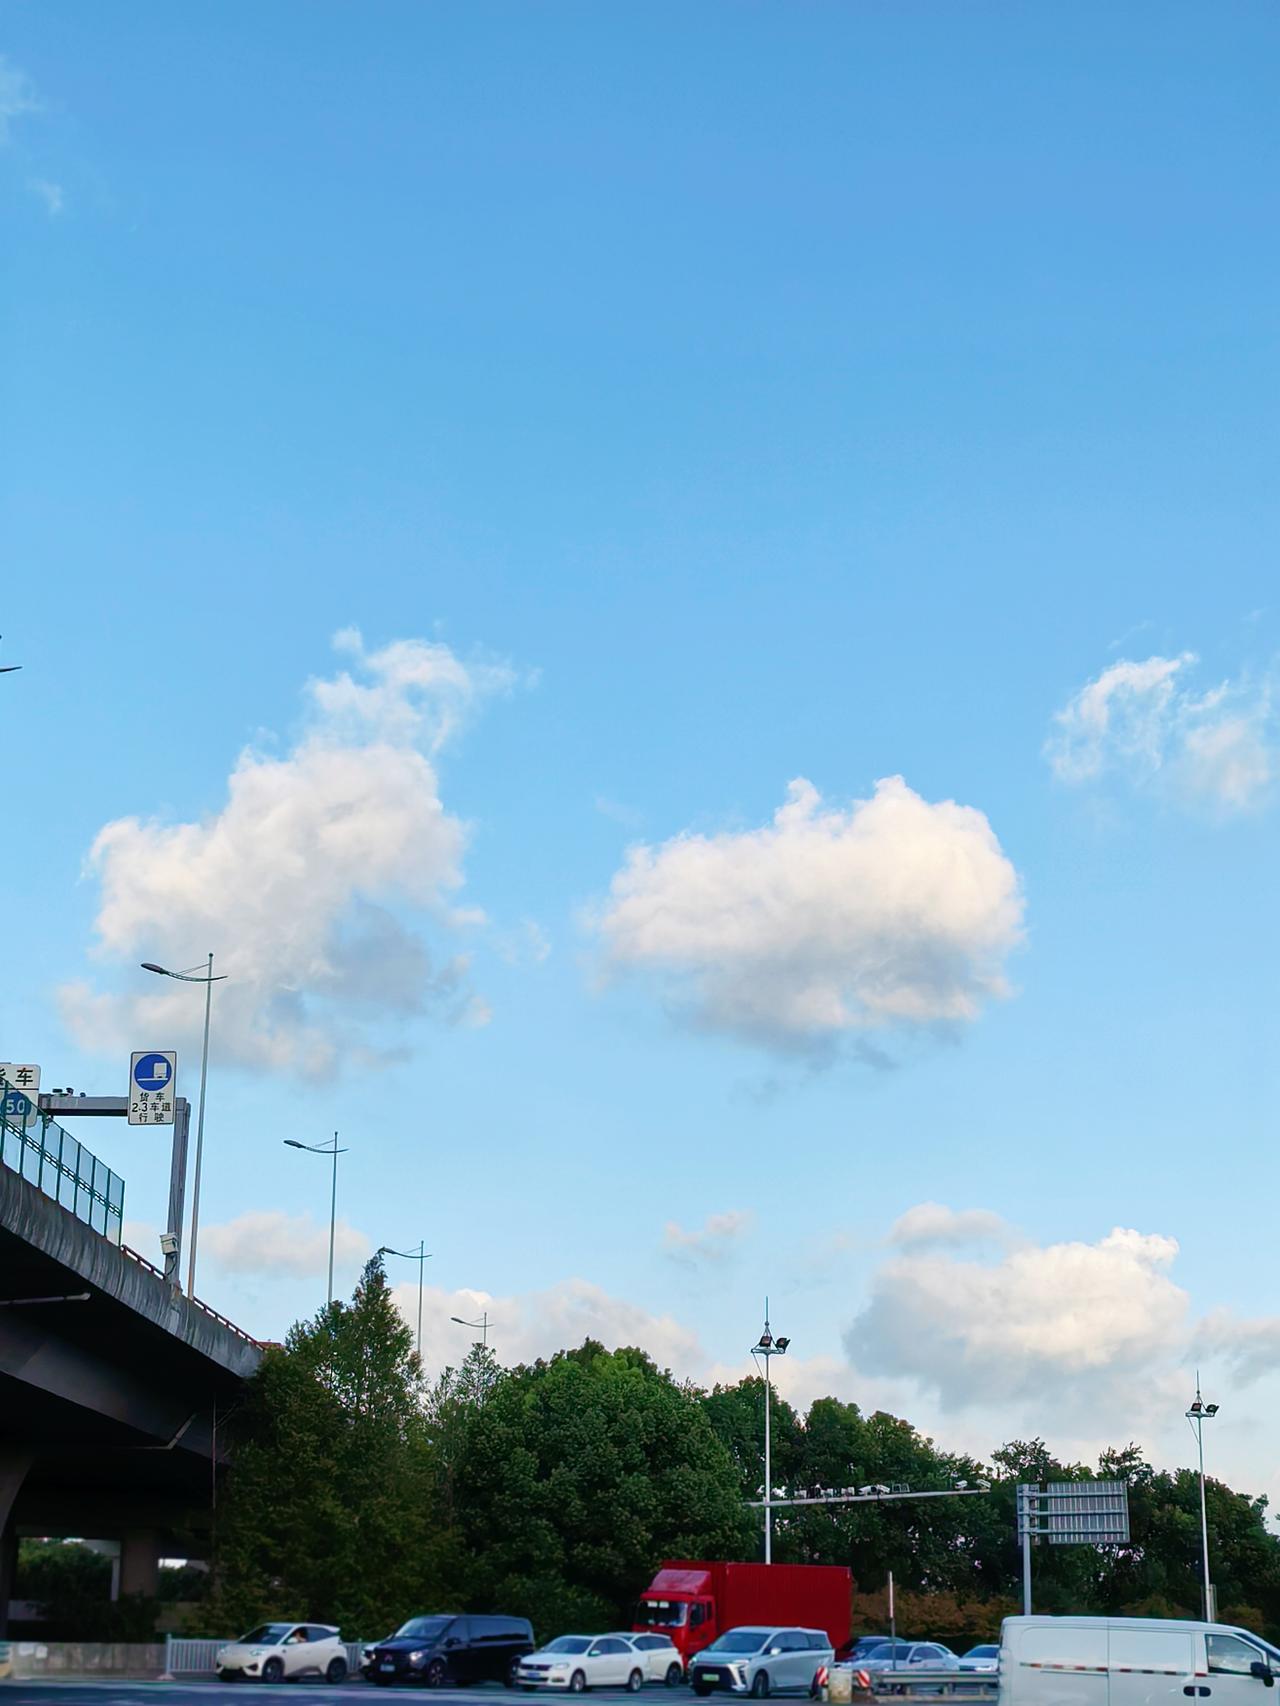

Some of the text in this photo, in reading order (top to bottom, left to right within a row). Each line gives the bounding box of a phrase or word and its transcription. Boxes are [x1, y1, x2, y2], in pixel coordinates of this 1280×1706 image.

[140, 1092, 165, 1102] 货车
[6, 1099, 26, 1113] 50
[139, 1113, 164, 1122] 行驶
